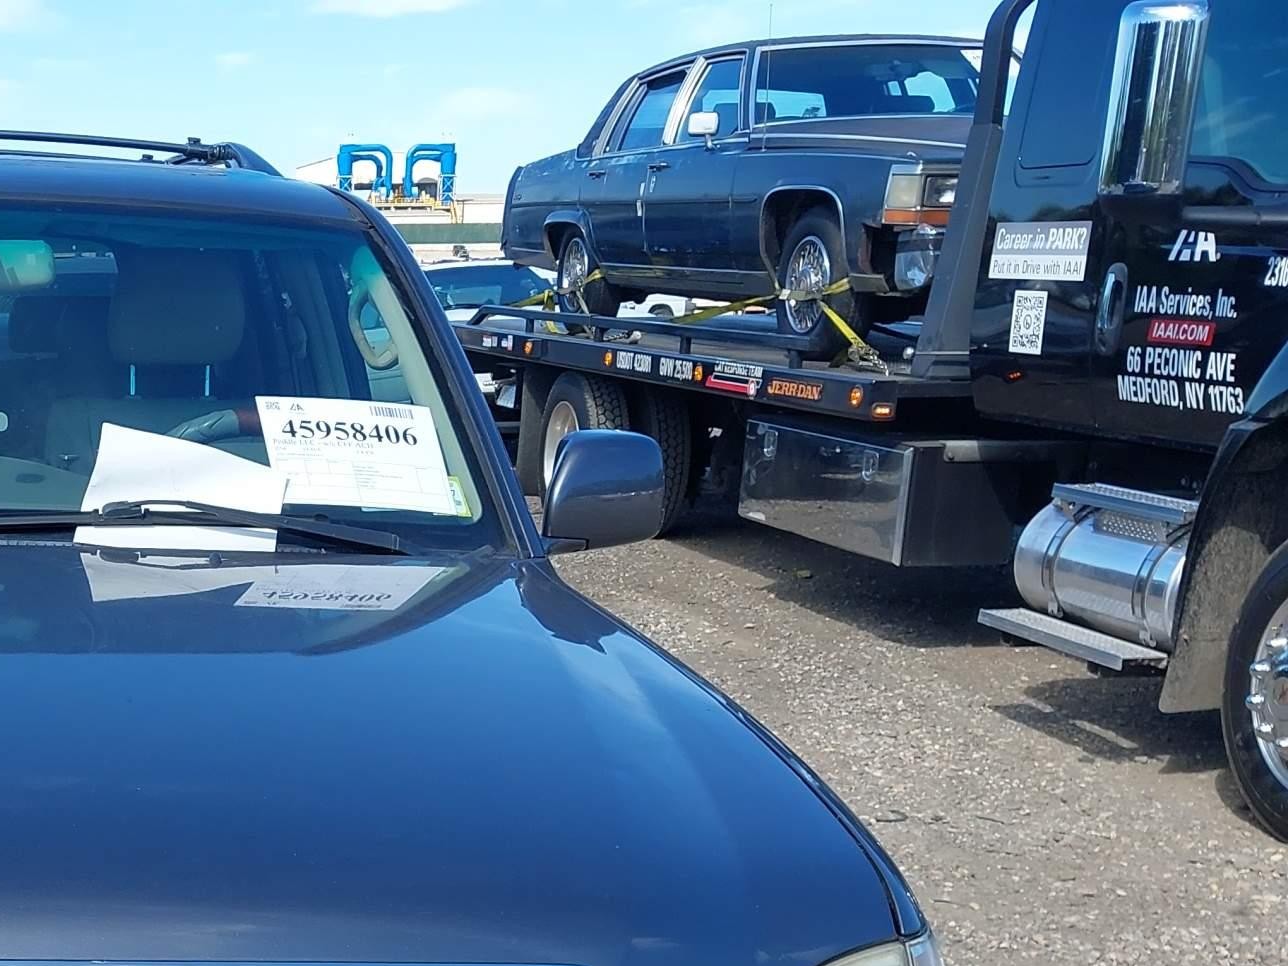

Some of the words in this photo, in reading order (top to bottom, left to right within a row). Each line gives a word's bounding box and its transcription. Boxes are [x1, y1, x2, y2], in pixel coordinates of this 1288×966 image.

[996, 227, 1033, 250] Career
[1032, 227, 1045, 250] in
[1045, 226, 1088, 250] PARK?
[993, 259, 1005, 274] Put
[1022, 259, 1041, 275] Drive
[1043, 259, 1061, 276] with
[1063, 260, 1082, 276] IAAI
[1134, 285, 1157, 313] IAA
[1159, 286, 1213, 320] Services,
[1215, 288, 1237, 319] Inc.
[1152, 321, 1210, 342] IAAI.COM
[616, 350, 635, 371] USDOT
[1126, 345, 1142, 374] 66
[1144, 346, 1202, 380] PECONIC
[1205, 351, 1237, 382] AVE
[1117, 374, 1184, 410] MEDFORD,
[1185, 381, 1205, 410] NY
[1208, 384, 1244, 415] 11763
[281, 419, 418, 446] 45958406
